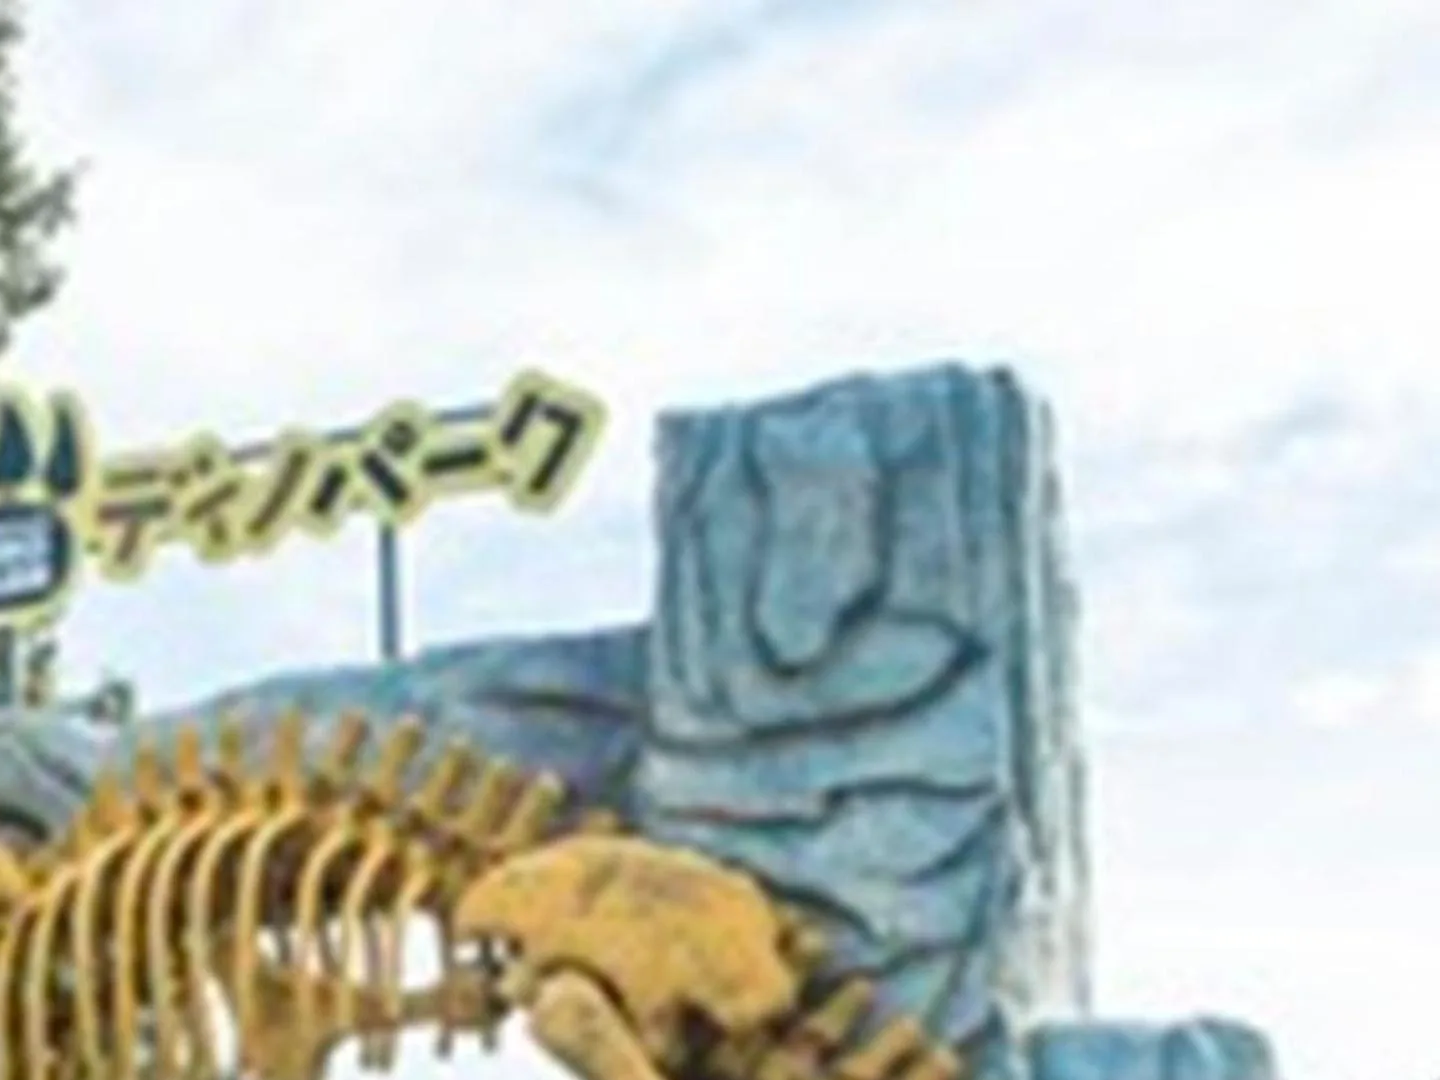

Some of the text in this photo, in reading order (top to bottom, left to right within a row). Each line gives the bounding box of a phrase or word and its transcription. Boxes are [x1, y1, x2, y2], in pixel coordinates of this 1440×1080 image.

[97, 391, 585, 565] ディノパーク
